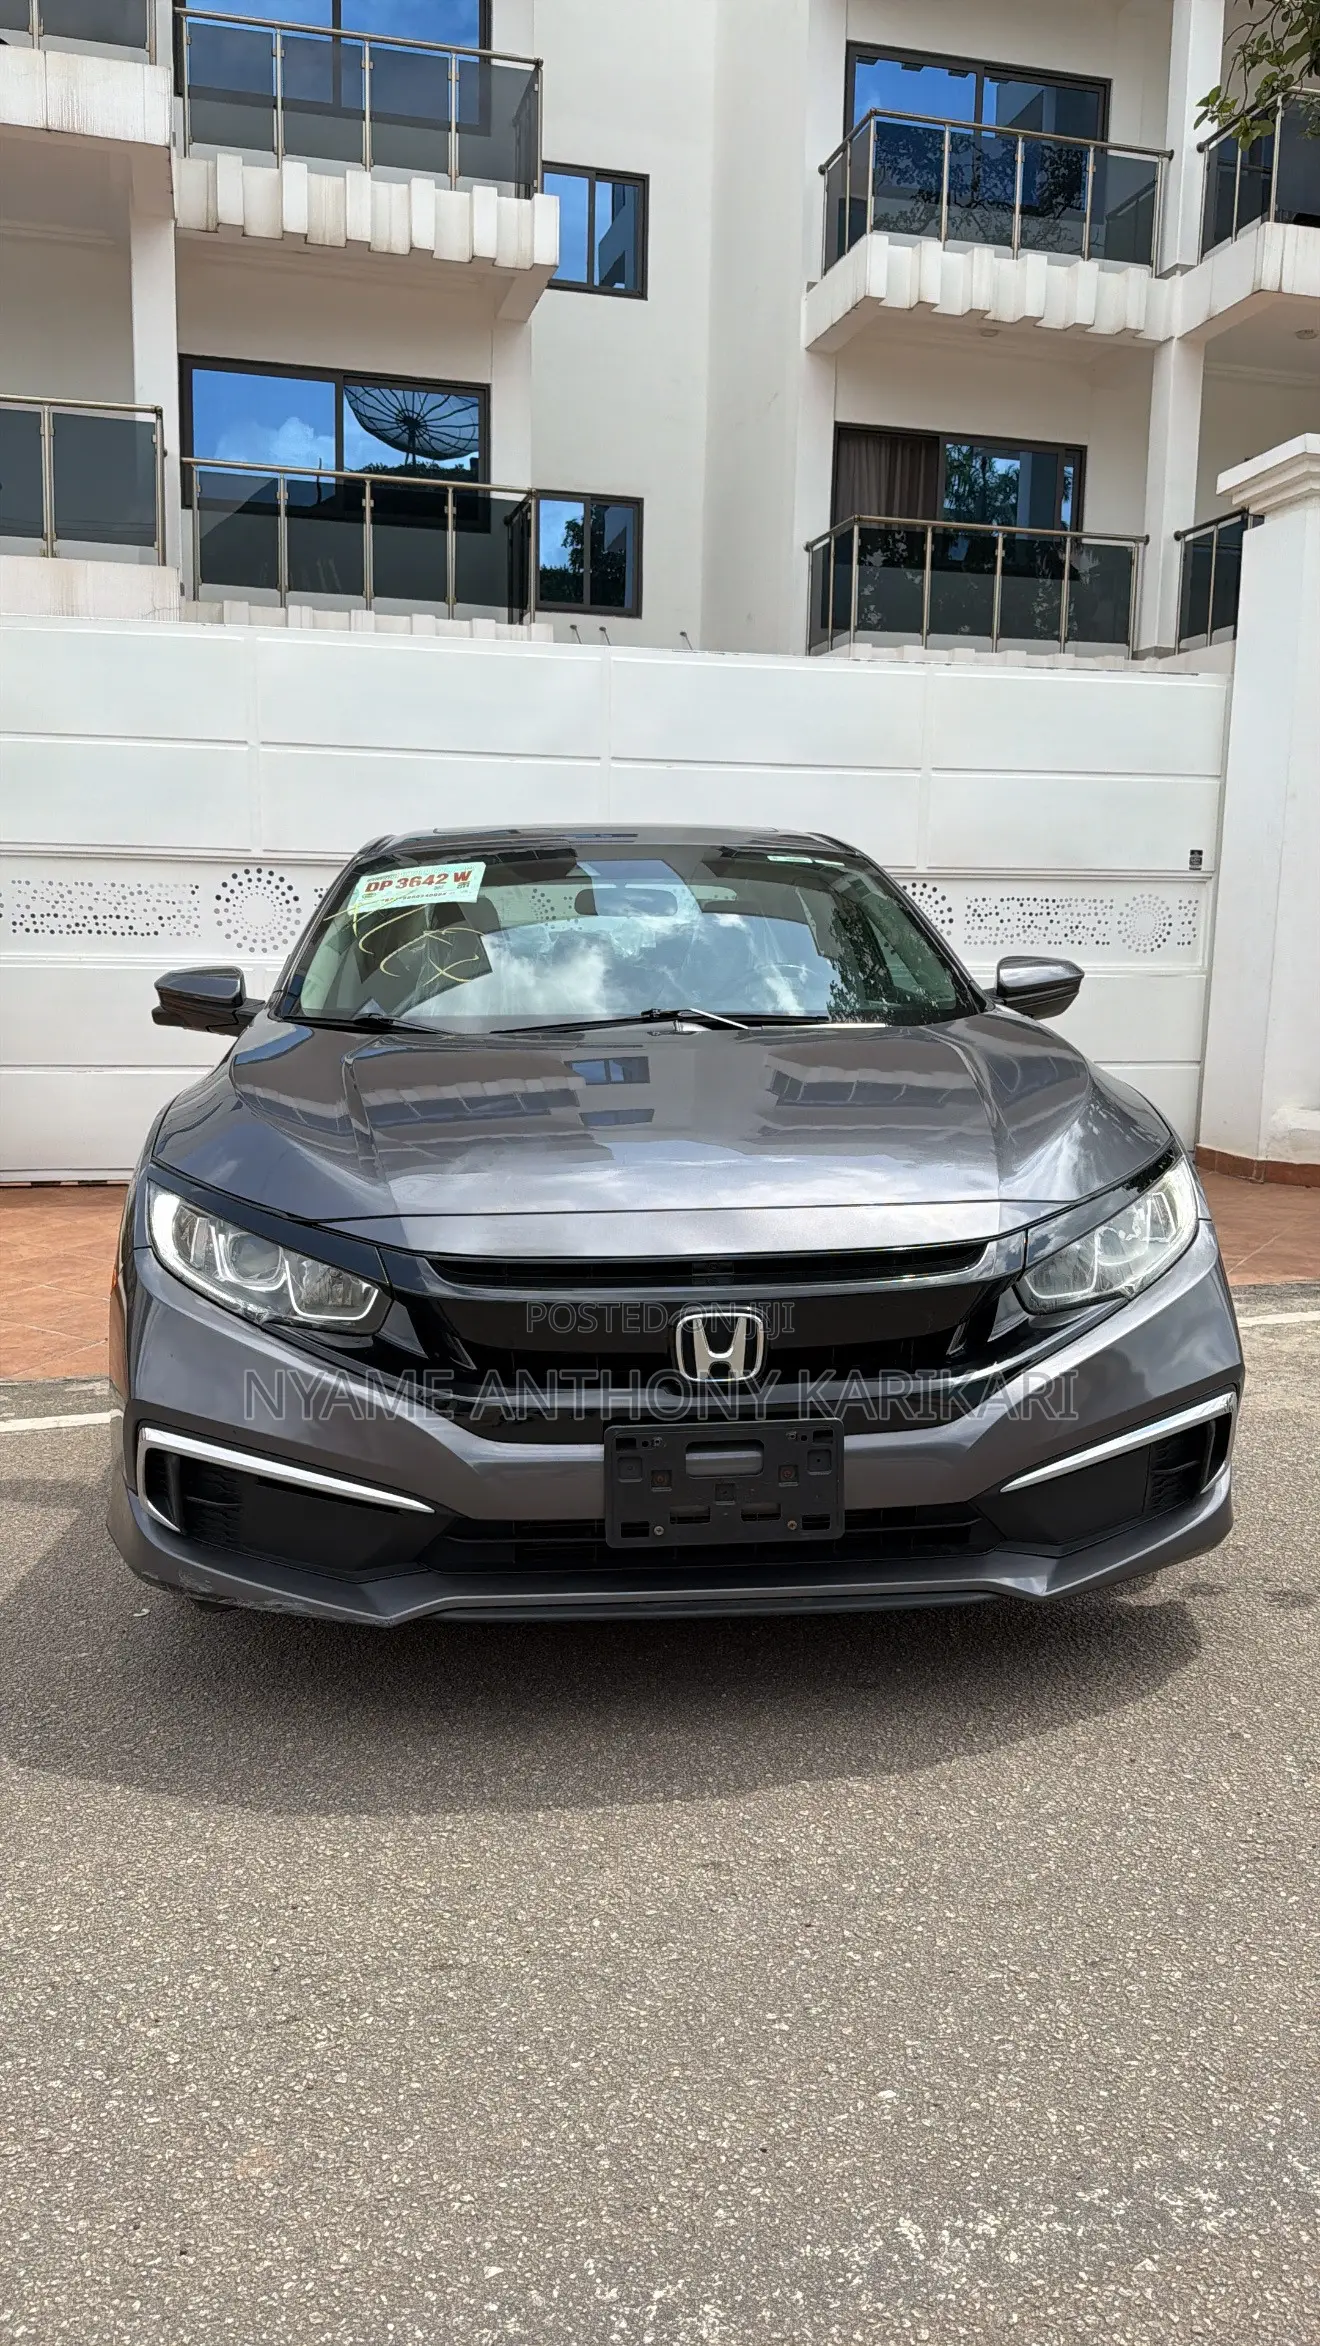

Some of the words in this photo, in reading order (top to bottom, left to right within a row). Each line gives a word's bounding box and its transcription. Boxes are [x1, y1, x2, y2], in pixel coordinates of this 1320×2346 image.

[365, 880, 393, 892] DP
[395, 873, 449, 889] 3642
[453, 870, 472, 882] W
